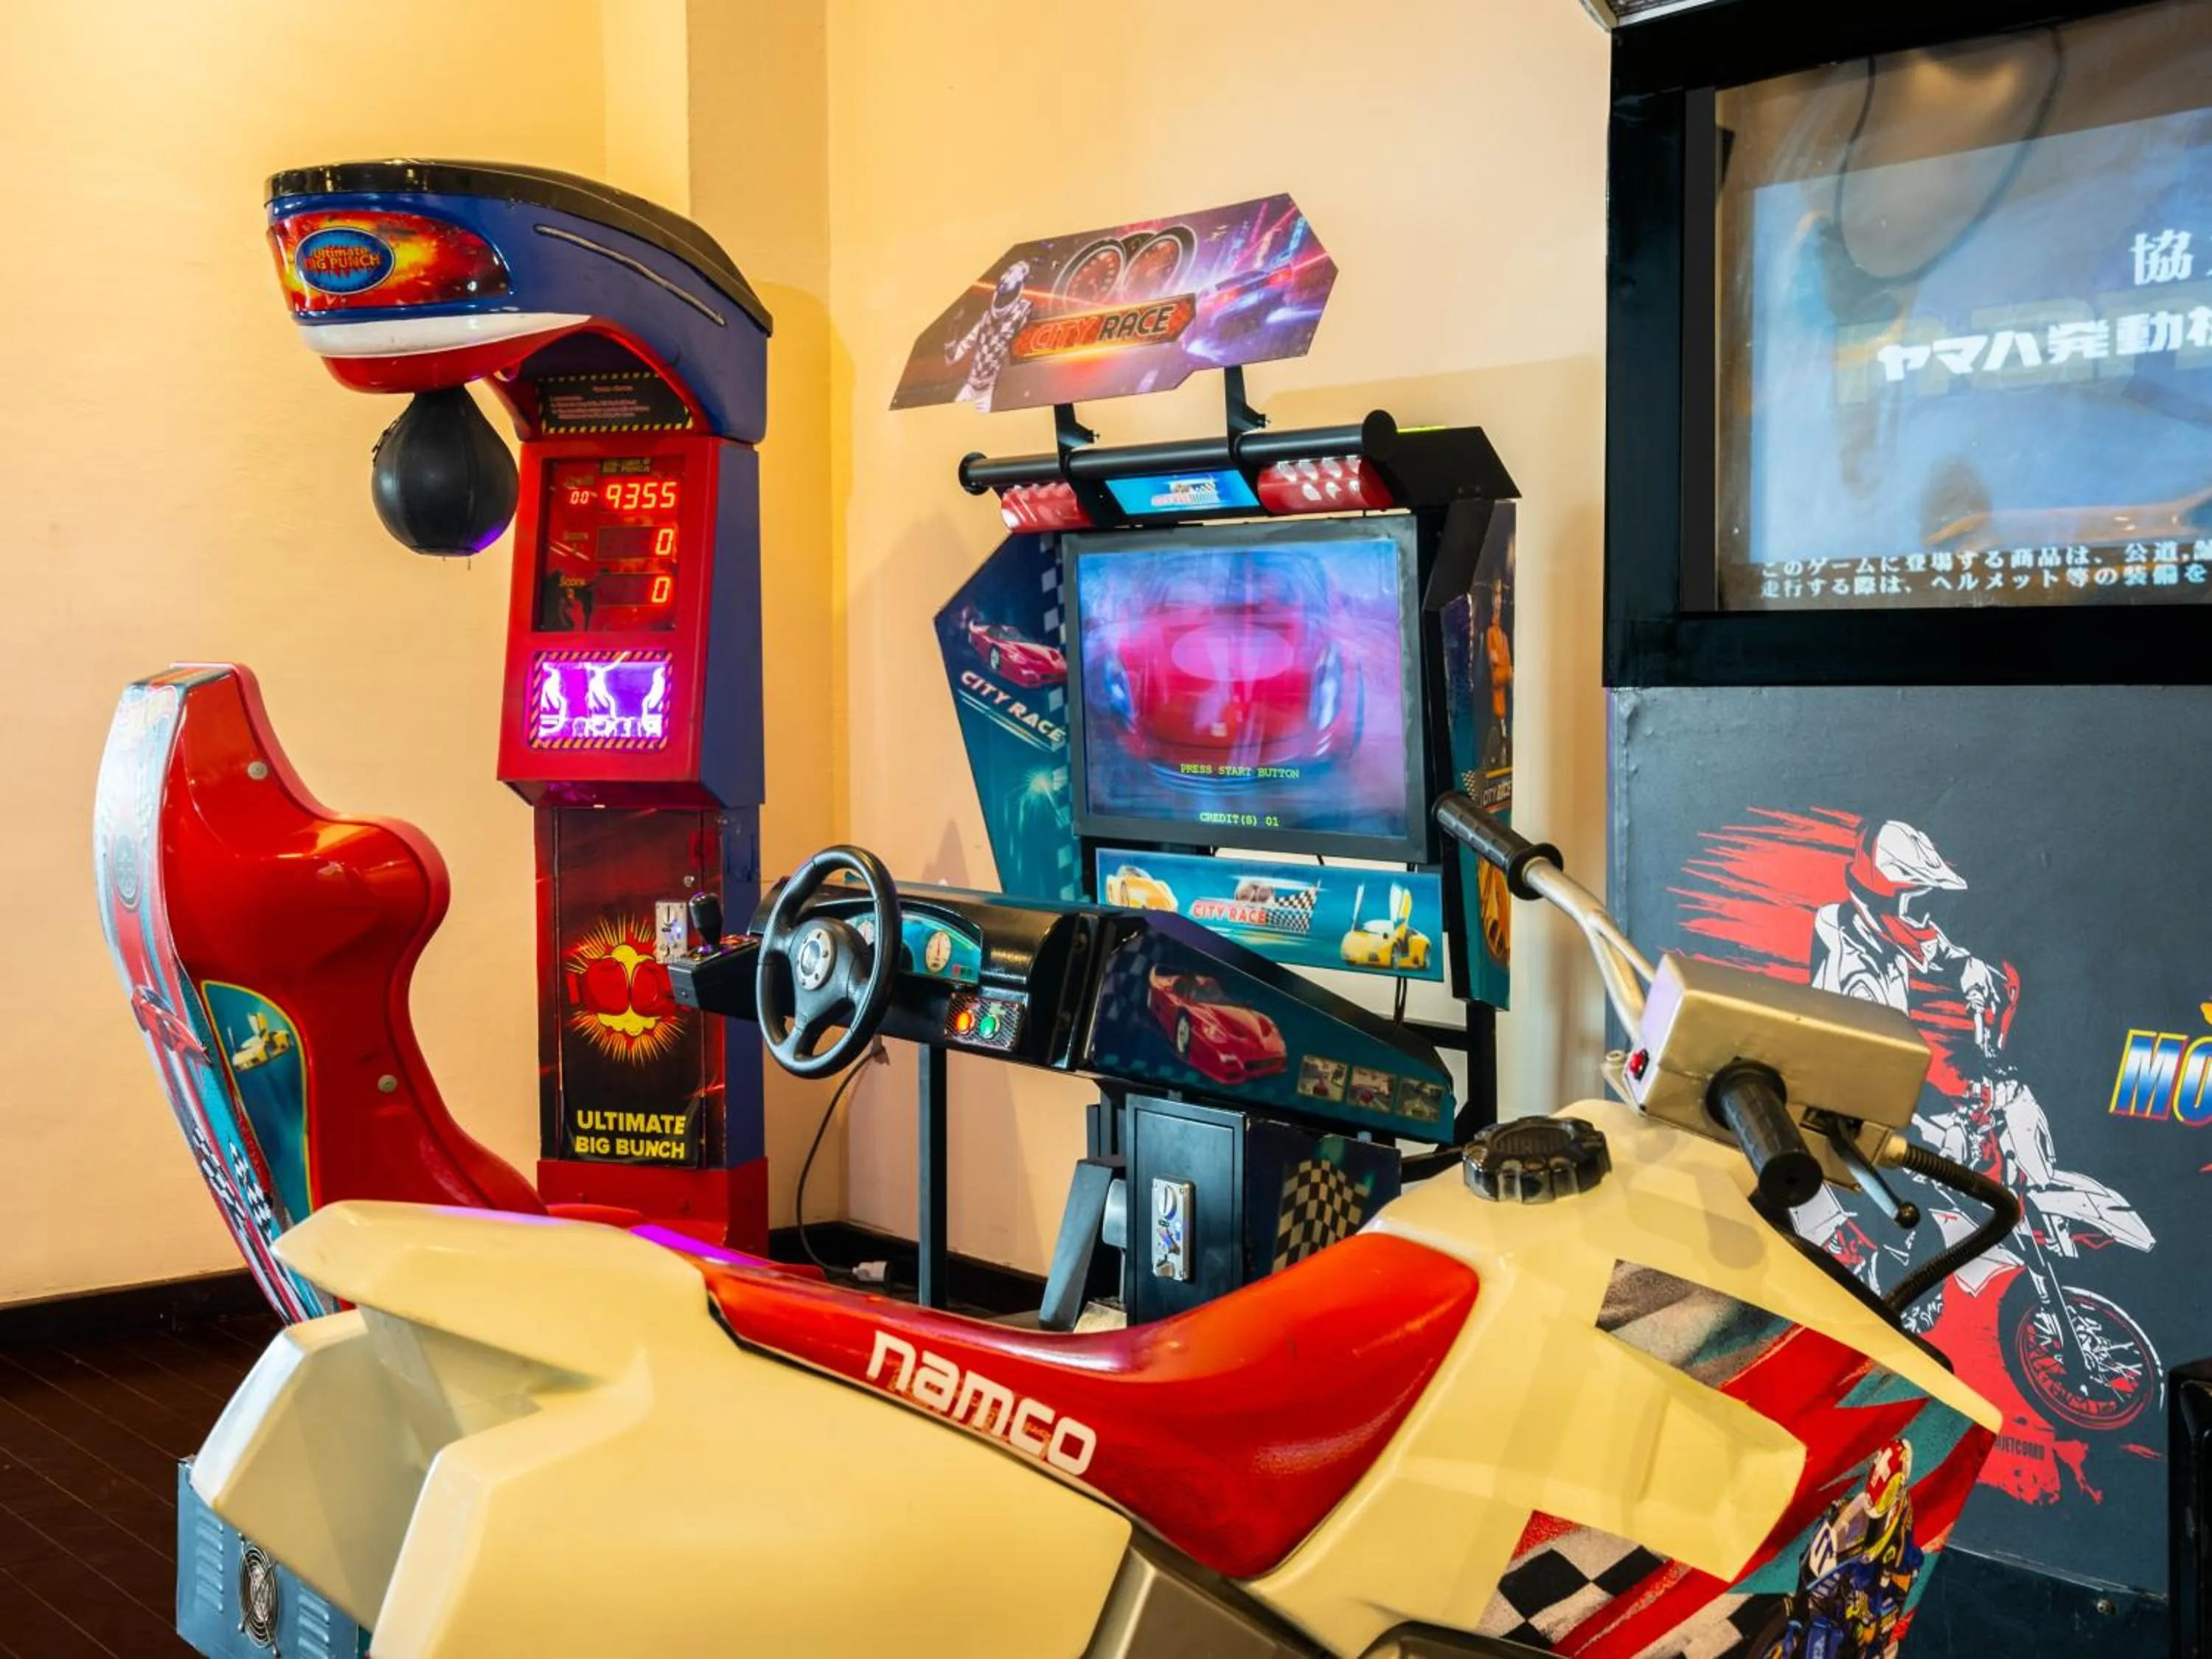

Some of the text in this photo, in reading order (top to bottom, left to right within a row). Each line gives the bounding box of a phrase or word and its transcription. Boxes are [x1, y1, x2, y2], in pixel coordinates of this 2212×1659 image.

[329, 253, 381, 269] PUNCH
[1032, 305, 1175, 351] CITY RACE
[605, 481, 677, 509] 9355
[655, 528, 674, 555] 0
[651, 576, 670, 603] 0
[961, 670, 1067, 742] CITY RACE
[1180, 763, 1299, 780] PRESS START BUTTON
[1199, 812, 1280, 827] CREDIT(S) 01
[1193, 901, 1267, 925] CITY RACE
[577, 1109, 686, 1135] ULTIMATE
[574, 1135, 685, 1160] BIG BUNCH
[865, 1329, 1097, 1476] namco
